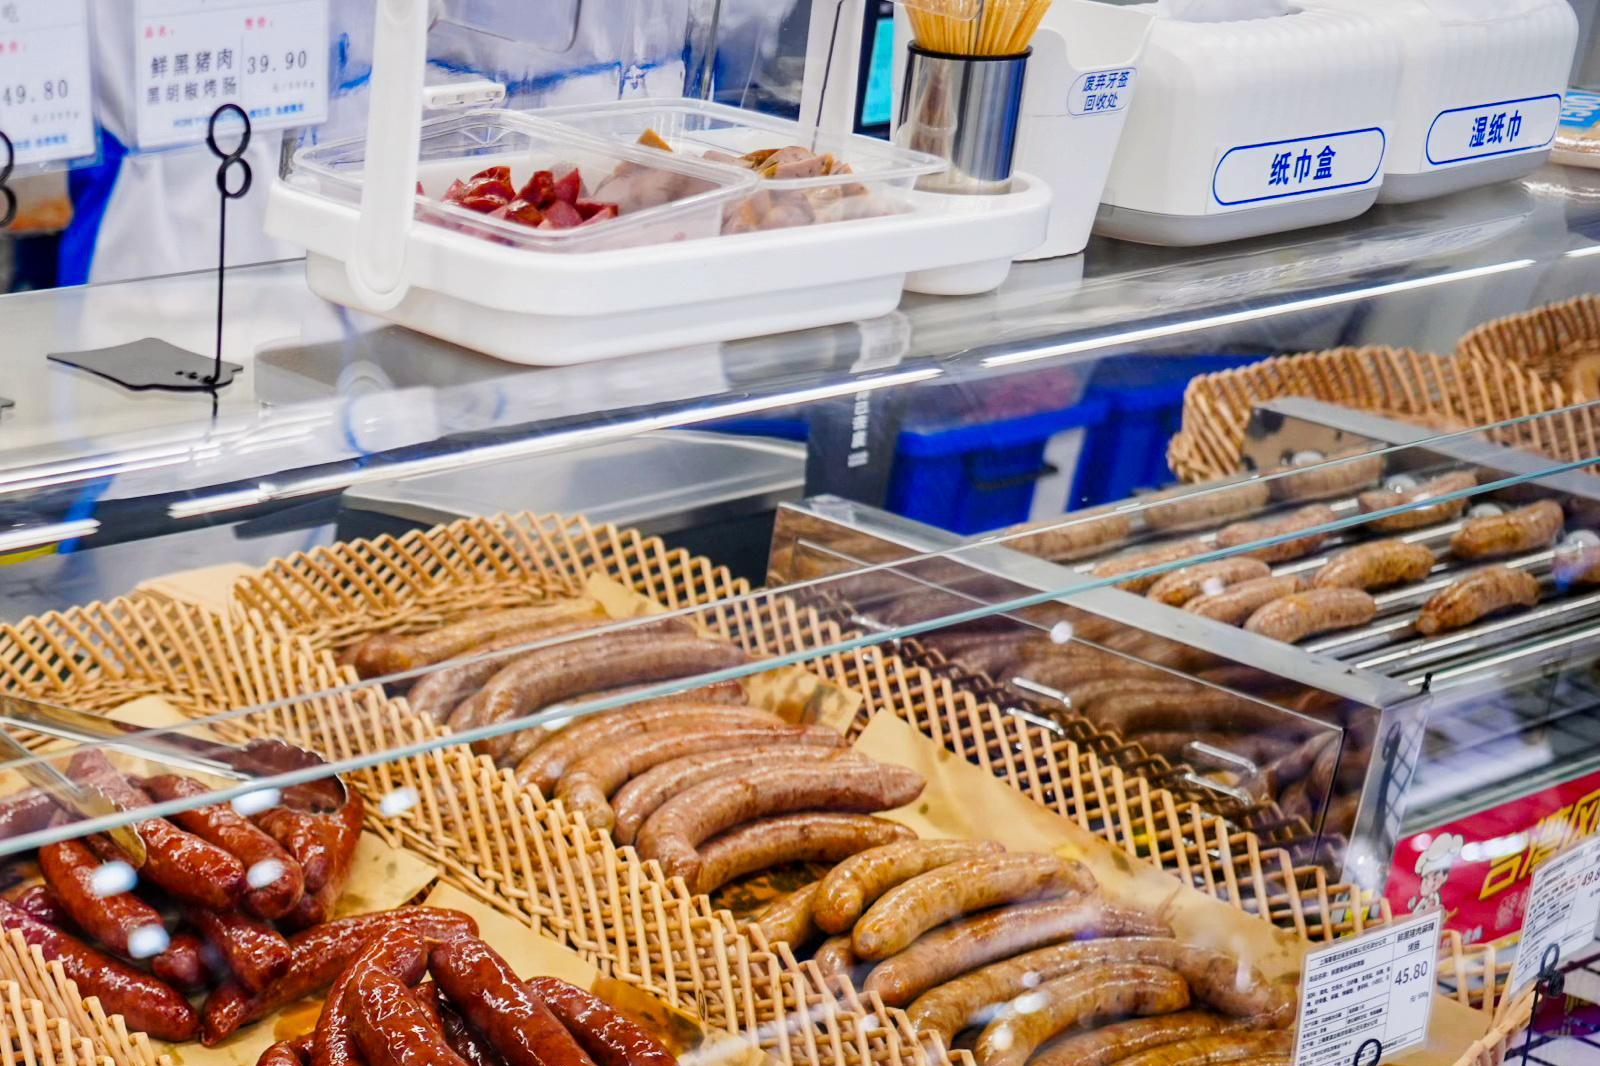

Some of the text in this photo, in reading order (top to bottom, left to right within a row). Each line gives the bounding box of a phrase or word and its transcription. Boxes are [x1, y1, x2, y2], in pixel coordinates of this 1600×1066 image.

[151, 48, 233, 79] 鲜黑猪肉
[247, 50, 308, 75] 39.90
[3, 79, 69, 106] 49.80
[147, 77, 237, 105] 黑胡椒烤肠
[1082, 71, 1130, 92] 废弃牙签
[1083, 92, 1118, 112] 回收处
[1468, 109, 1523, 148] 湿纸巾
[1268, 145, 1337, 186] 纸巾盒
[1394, 960, 1429, 986] 45.80
